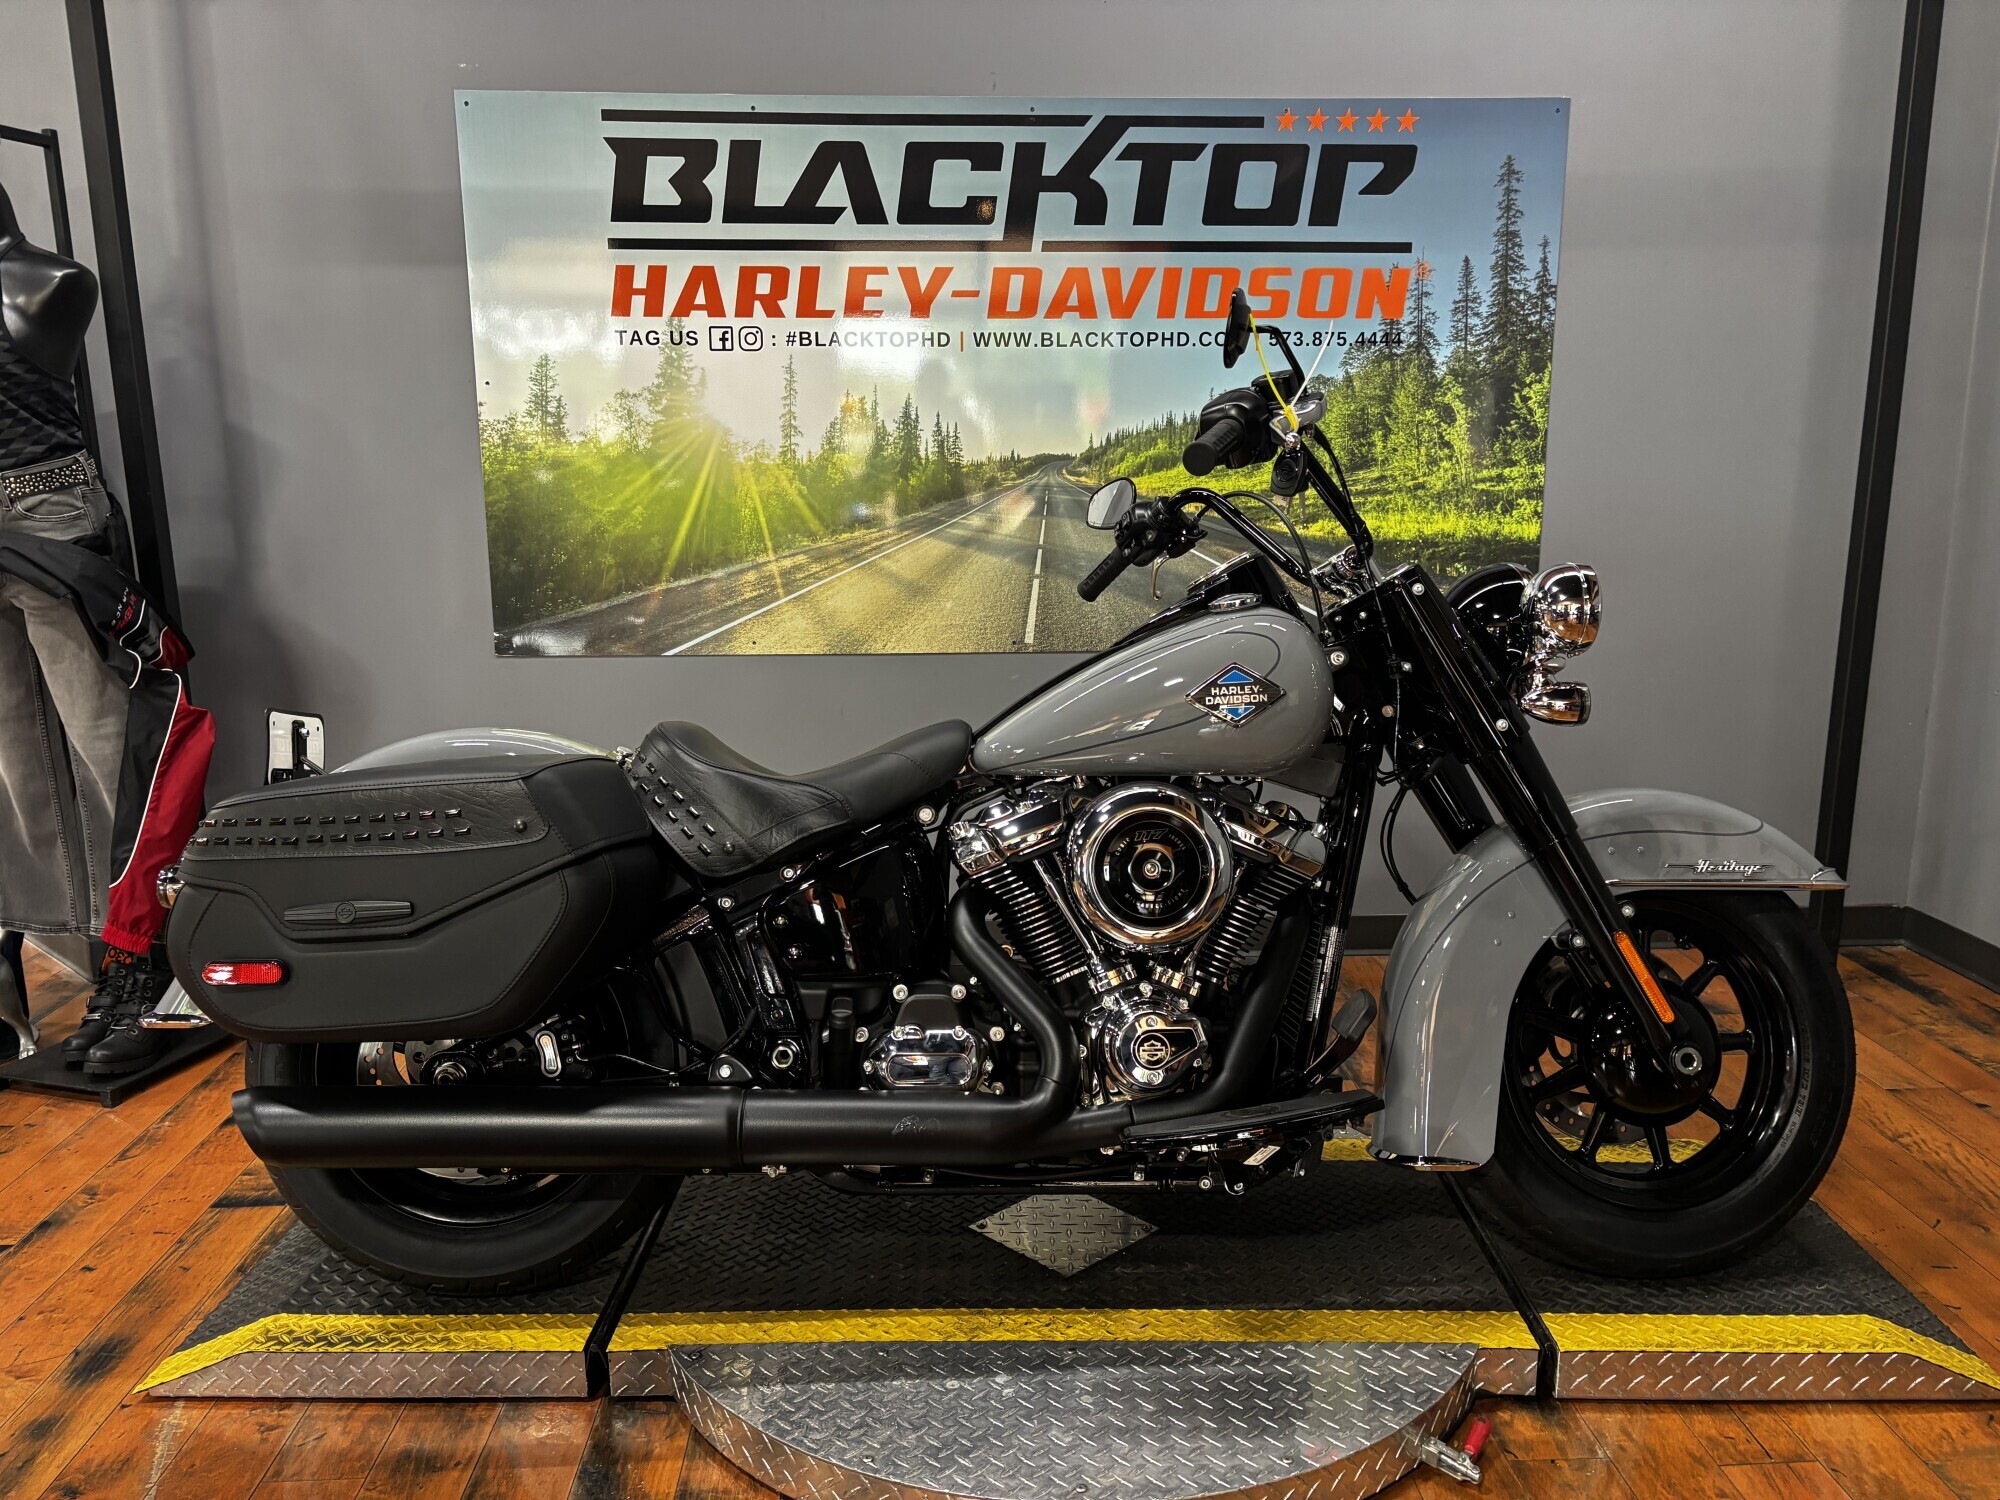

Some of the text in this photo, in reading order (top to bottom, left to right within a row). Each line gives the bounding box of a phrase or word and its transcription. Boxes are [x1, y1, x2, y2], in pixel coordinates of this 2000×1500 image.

[603, 116, 1419, 252] BLACKTOP
[615, 330, 660, 347] TAG
[669, 330, 699, 347] US
[785, 331, 951, 348] #BLACKTOPHD
[972, 331, 1226, 347] WWW.BLACKTOPHD.CO
[1205, 694, 1268, 705] DAVIDSON
[1133, 828, 1169, 842] 117
[1694, 858, 1765, 877] Heritage
